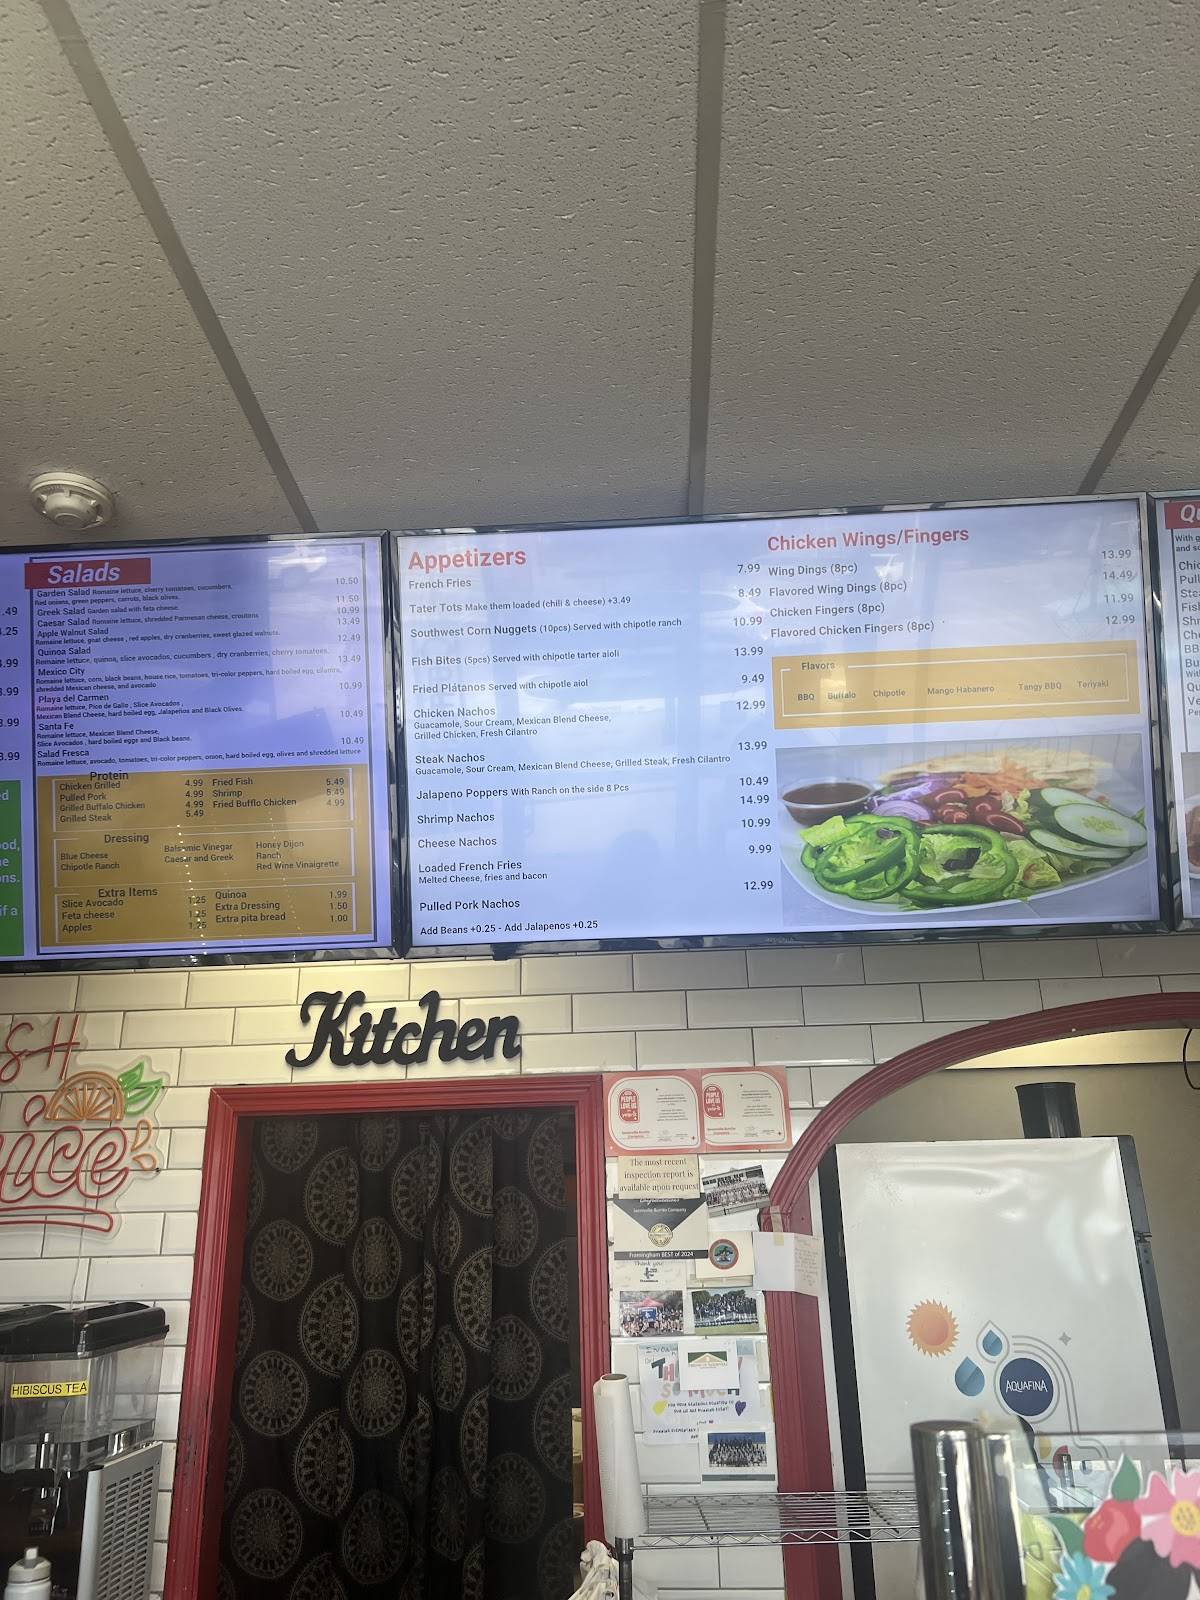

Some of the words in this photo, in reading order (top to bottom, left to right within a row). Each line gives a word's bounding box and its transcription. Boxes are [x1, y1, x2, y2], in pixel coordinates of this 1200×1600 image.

[768, 533, 836, 551] Chicken
[842, 527, 969, 552] Wings/Fingers
[408, 547, 527, 573] Appetizers
[1101, 549, 1131, 560] 13.99
[737, 563, 760, 574] 7.99
[768, 566, 795, 578] Wing
[797, 564, 827, 577] Dings
[830, 563, 858, 576] (8pc)
[47, 565, 120, 584] Salads
[409, 579, 443, 589] French
[446, 578, 472, 588] Fries
[37, 587, 67, 597] Garden
[68, 586, 90, 596] Salad
[738, 587, 761, 598] 8.49
[1104, 592, 1134, 603] 11.99
[37, 606, 60, 616] Greek
[62, 606, 85, 615] Salad
[410, 603, 436, 614] Tater
[440, 602, 462, 613] Tots
[465, 603, 487, 612] Make
[489, 602, 510, 610] them
[511, 601, 541, 610] loaded
[542, 600, 563, 610] (chili
[571, 598, 605, 608] cheese)
[607, 597, 631, 605] +3.49
[770, 606, 812, 617] Chicken
[815, 604, 854, 617] Fingers
[856, 603, 885, 616] (8pc)
[37, 617, 65, 627] Caesar
[67, 616, 90, 626] Salad
[1105, 614, 1135, 625] 12.99
[37, 628, 59, 639] Apple
[60, 627, 86, 636] Walnut
[87, 626, 108, 635] Salad
[410, 626, 463, 638] Southwest
[466, 625, 491, 636] Corn
[494, 624, 536, 637] Nuggets
[539, 624, 570, 635] (10pcs)
[572, 622, 602, 632] Served
[603, 622, 620, 630] with
[622, 620, 656, 631] chipotle
[658, 619, 682, 628] ranch
[770, 626, 815, 638] Flavored
[818, 624, 862, 636] Chicken
[864, 622, 903, 636] Fingers
[906, 621, 934, 634] (8pc)
[37, 646, 66, 658] Quinoa
[68, 645, 91, 654] Salad
[734, 646, 764, 657] 13.99
[412, 656, 432, 666] Fish
[434, 655, 462, 665] Bites
[464, 655, 490, 666] (5pcs)
[492, 654, 520, 663] Served
[522, 653, 541, 662] with
[542, 652, 575, 663] chipotle
[576, 651, 599, 660] tarter
[38, 666, 67, 676] Mexico
[69, 666, 85, 676] City
[412, 684, 438, 694] Fried
[441, 682, 486, 693] Plátanos
[927, 686, 955, 696] Mango
[956, 684, 994, 693] Habanero
[38, 693, 60, 704] Playa
[62, 693, 76, 702] del
[77, 692, 109, 701] Carmen
[736, 700, 766, 711] 12.99
[414, 708, 454, 718] Chicken
[457, 706, 496, 717] Nachos
[39, 721, 62, 731] Santa
[63, 720, 74, 730] Fe
[341, 736, 364, 745] 10.49
[737, 740, 767, 751] 13.99
[37, 748, 59, 758] Salad
[61, 747, 89, 757] Fresca
[415, 754, 444, 764] Steak
[446, 752, 485, 763] Nachos
[90, 769, 129, 780] Protein
[212, 778, 233, 786] Fried
[235, 777, 253, 785] Fish
[739, 776, 769, 787] 10.49
[59, 792, 86, 801] Pulled
[87, 792, 106, 800] Pork
[212, 788, 242, 799] Shrimp
[416, 789, 462, 802] Jalapeno
[465, 787, 508, 800] Poppers
[530, 787, 558, 795] Ranch
[213, 800, 233, 808] Fried
[263, 797, 296, 806] Chicken
[417, 814, 453, 826] Shrimp
[456, 812, 495, 823] Nachos
[104, 832, 149, 845] Dressing
[418, 838, 455, 848] Cheese
[457, 837, 497, 847] Nachos
[748, 844, 772, 854] 9.99
[418, 862, 456, 873] Loaded
[459, 861, 493, 872] French
[497, 860, 522, 870] Fries
[744, 880, 773, 891] 12.99
[98, 887, 125, 898] Extra
[128, 886, 158, 896] Items
[215, 890, 246, 900] Quinoa
[329, 890, 347, 898] 1.99
[216, 902, 238, 911] Extra
[240, 900, 280, 912] Dressing
[330, 901, 347, 910] 1.50
[419, 901, 451, 911] Pulled
[454, 900, 478, 910] Pork
[481, 899, 520, 909] Nachos
[216, 914, 238, 922] Extra
[240, 913, 257, 923] pita
[258, 912, 286, 921] bread
[330, 913, 348, 922] 1.00
[420, 926, 438, 935] Add
[440, 925, 468, 934] Beans
[470, 924, 495, 933] +0.25
[504, 923, 522, 932] Add
[524, 921, 570, 933] Jalapenos
[572, 920, 598, 930] +0.25
[285, 990, 522, 1068] Kitchen
[12, 1384, 62, 1396] HIBISCUS
[65, 1382, 87, 1394] TEA
[1005, 1380, 1048, 1393] AQUAFINA
